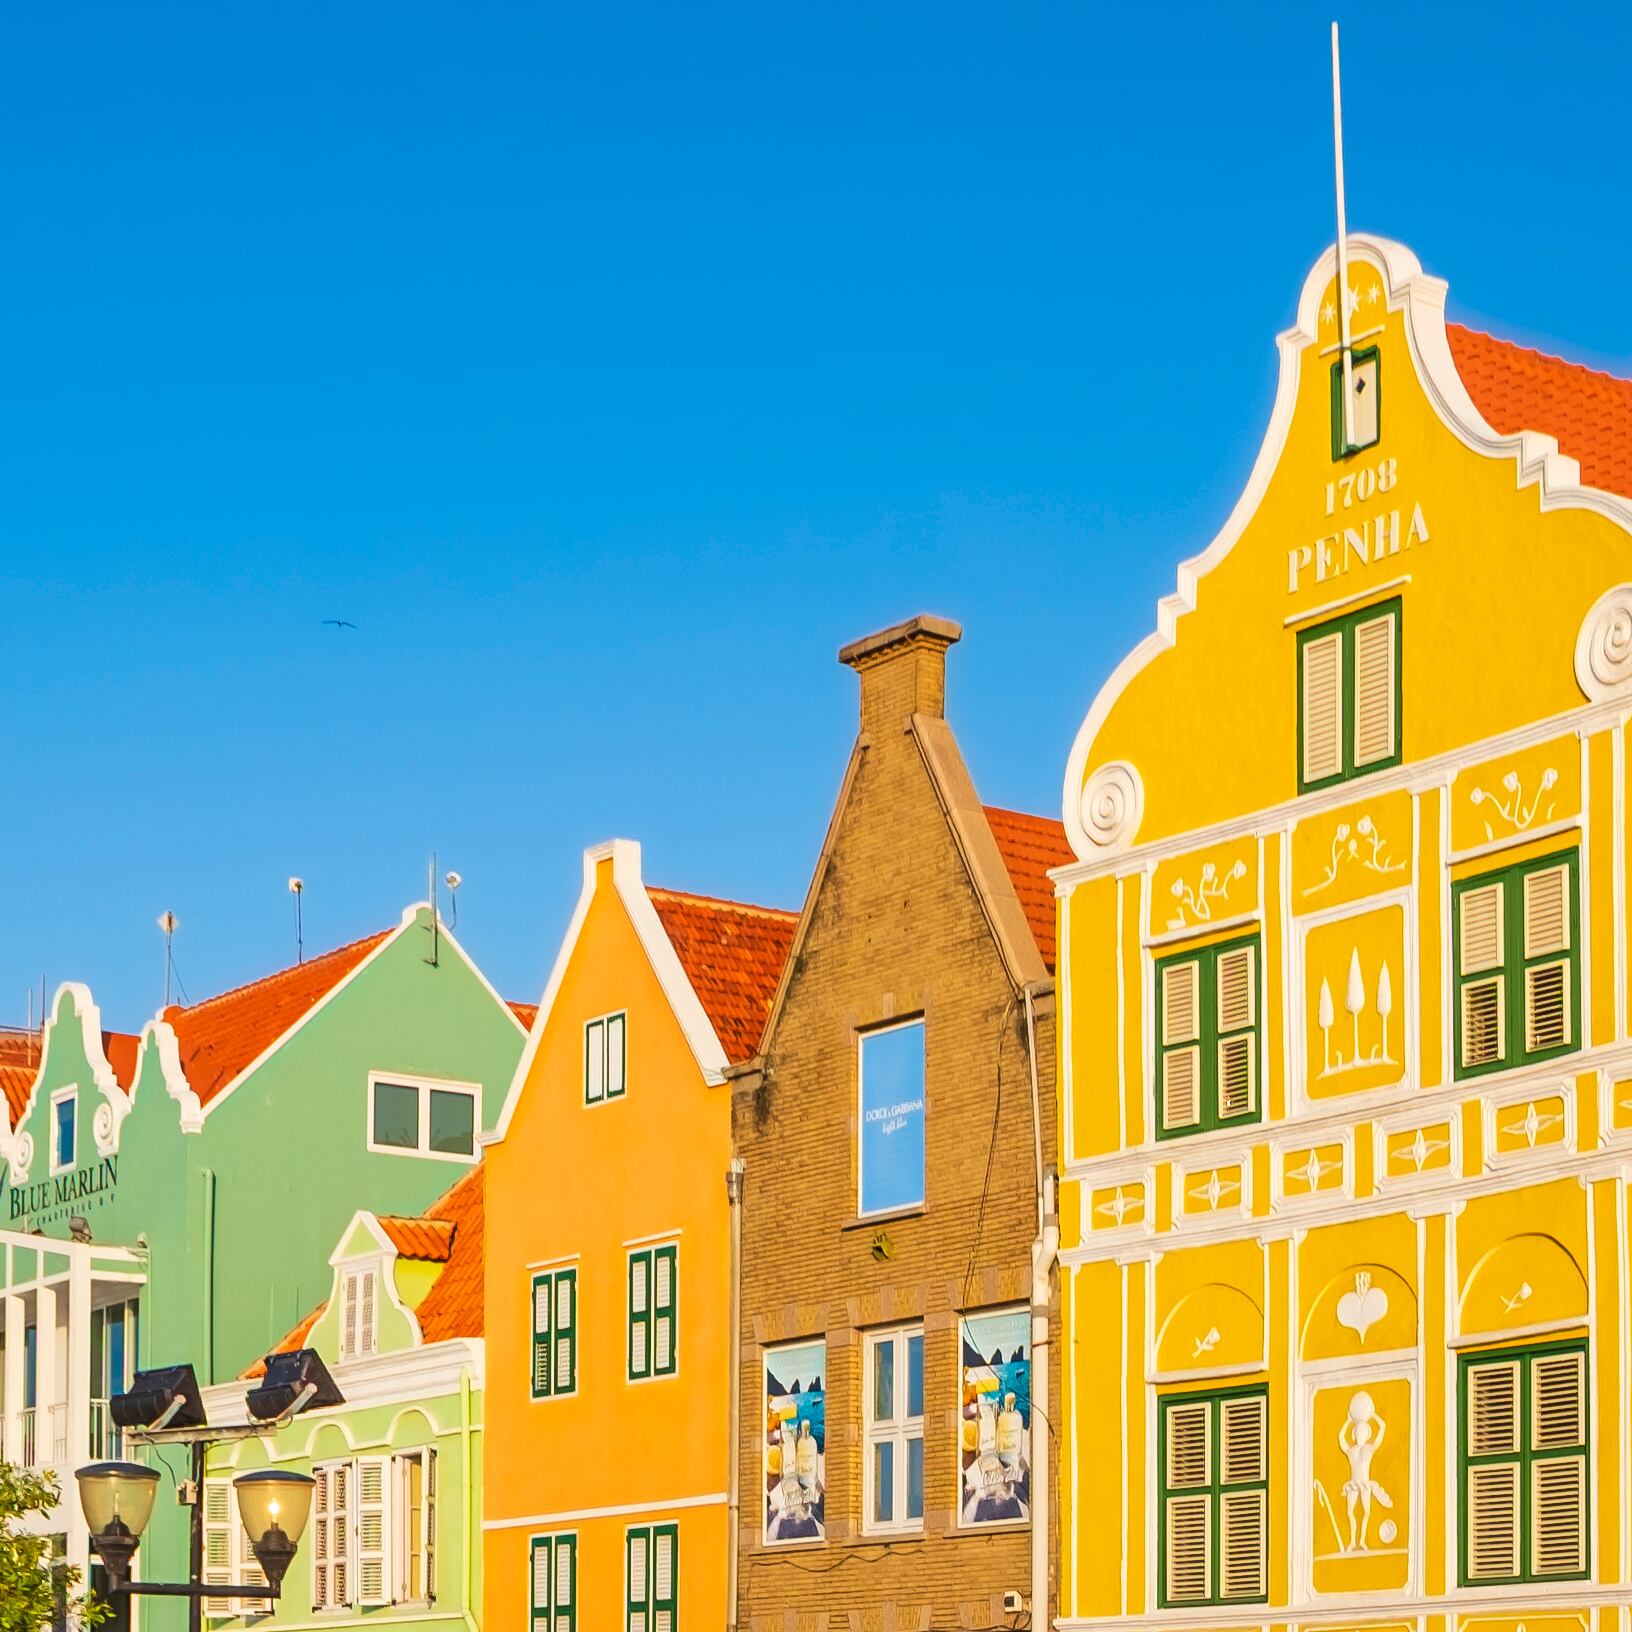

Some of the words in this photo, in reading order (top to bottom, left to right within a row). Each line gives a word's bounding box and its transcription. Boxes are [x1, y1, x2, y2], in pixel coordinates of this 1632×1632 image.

[1324, 458, 1398, 518] 1708
[1286, 501, 1431, 595] PENHA
[10, 1180, 51, 1220] BLUE
[54, 1155, 119, 1206] MARLIN
